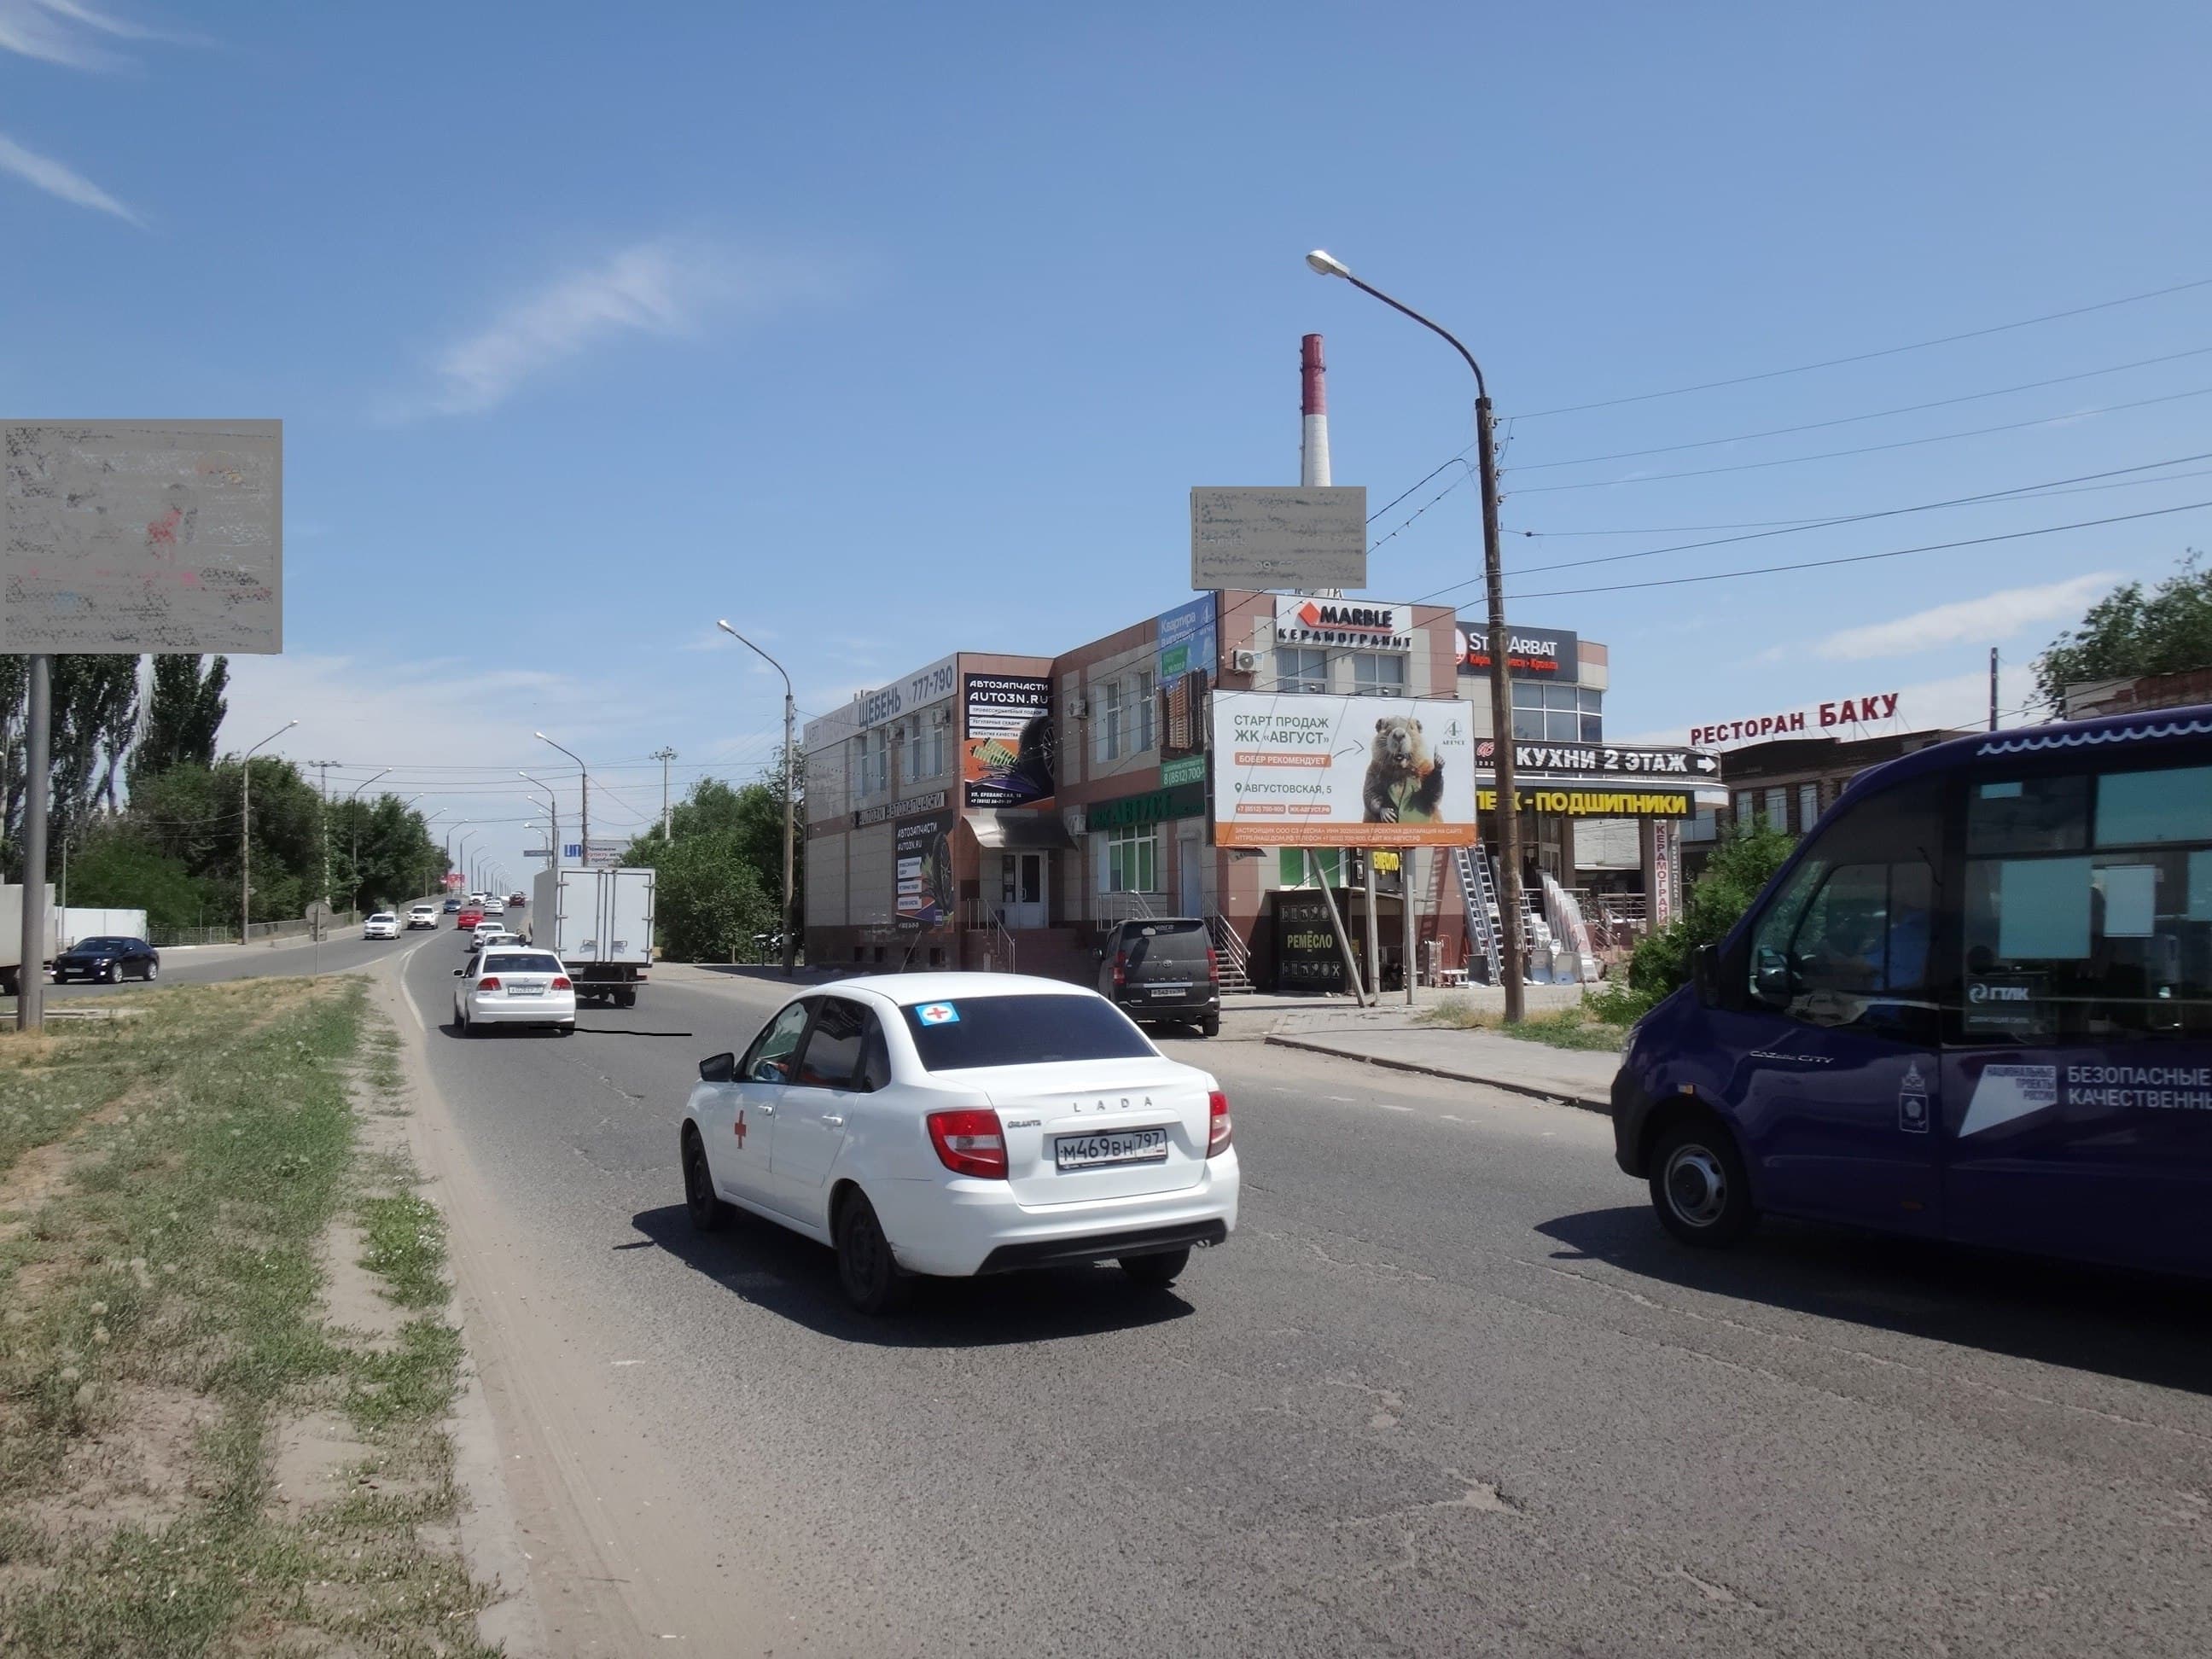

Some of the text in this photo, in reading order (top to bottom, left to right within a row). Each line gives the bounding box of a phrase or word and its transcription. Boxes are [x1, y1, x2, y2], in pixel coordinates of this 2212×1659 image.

[1319, 605, 1393, 628] MARBLE
[1278, 627, 1412, 648] КЕРАМОГРАНИТ
[969, 680, 1048, 690] АВТОЗАПЧАСТИ
[859, 687, 901, 729] ЩЕБЕНЬ
[912, 665, 953, 702] 777-790
[1234, 715, 1329, 730] СТАРТ ПРОДАЖ
[1691, 693, 1899, 746] РЕСТОРАН БАКУ
[1235, 730, 1330, 744] ЖК «АВГУСТ»
[1267, 756, 1325, 765] РЕКОМЕНДУЕТ
[1516, 747, 1595, 769] КУХНИ
[1604, 748, 1619, 770] 2
[1625, 753, 1688, 772] ЭТАЖ
[1244, 783, 1331, 795] АВГУСТОВСКАЯ, 5
[1537, 792, 1686, 815] ПОДШИПНИКИ
[898, 822, 937, 840] АВТОЗАПЧАСТИ
[1656, 825, 1668, 927] КЕРАМОГРАНИ
[1074, 1097, 1153, 1112] LADA
[1063, 1132, 1159, 1161] М469ВН 797
